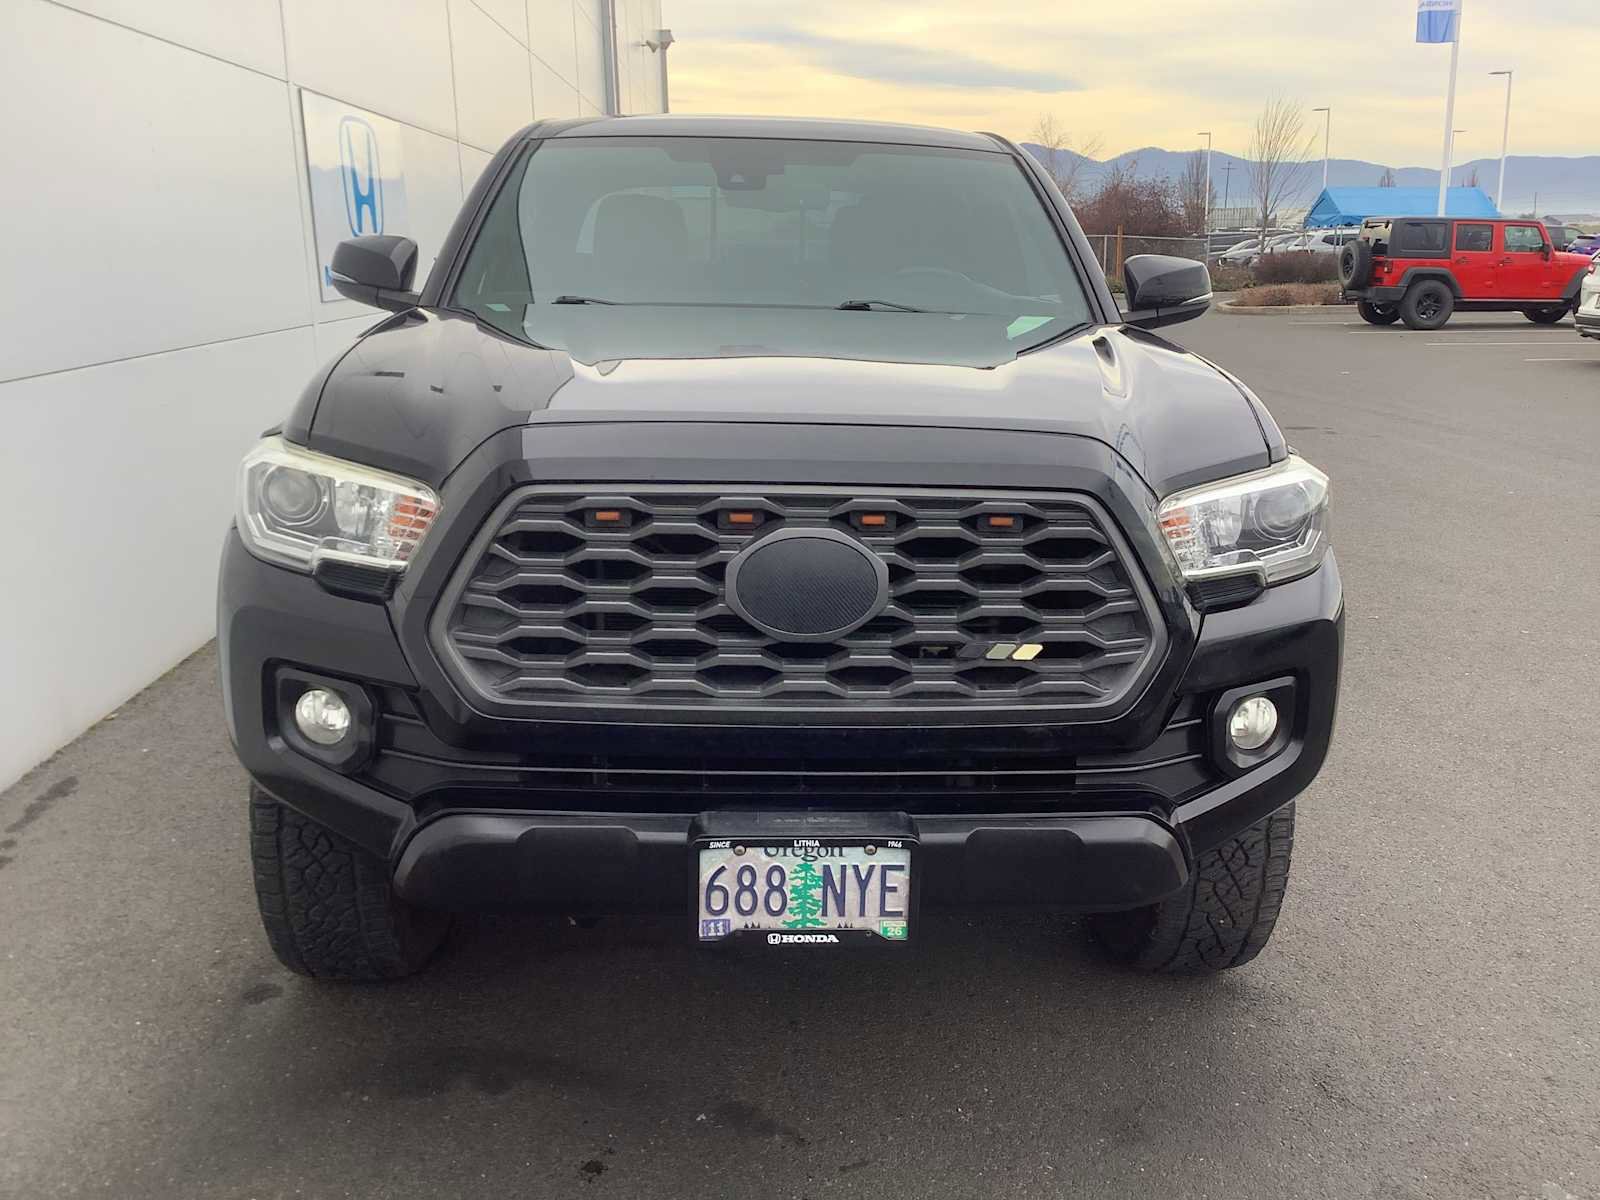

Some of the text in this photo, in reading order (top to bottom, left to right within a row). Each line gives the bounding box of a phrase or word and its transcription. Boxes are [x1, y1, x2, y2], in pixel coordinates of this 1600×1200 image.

[709, 841, 731, 849] SINCE
[793, 839, 820, 847] LITHIA
[705, 864, 905, 917] 688 NYE
[887, 927, 902, 936] 26
[781, 934, 840, 943] HONDA
